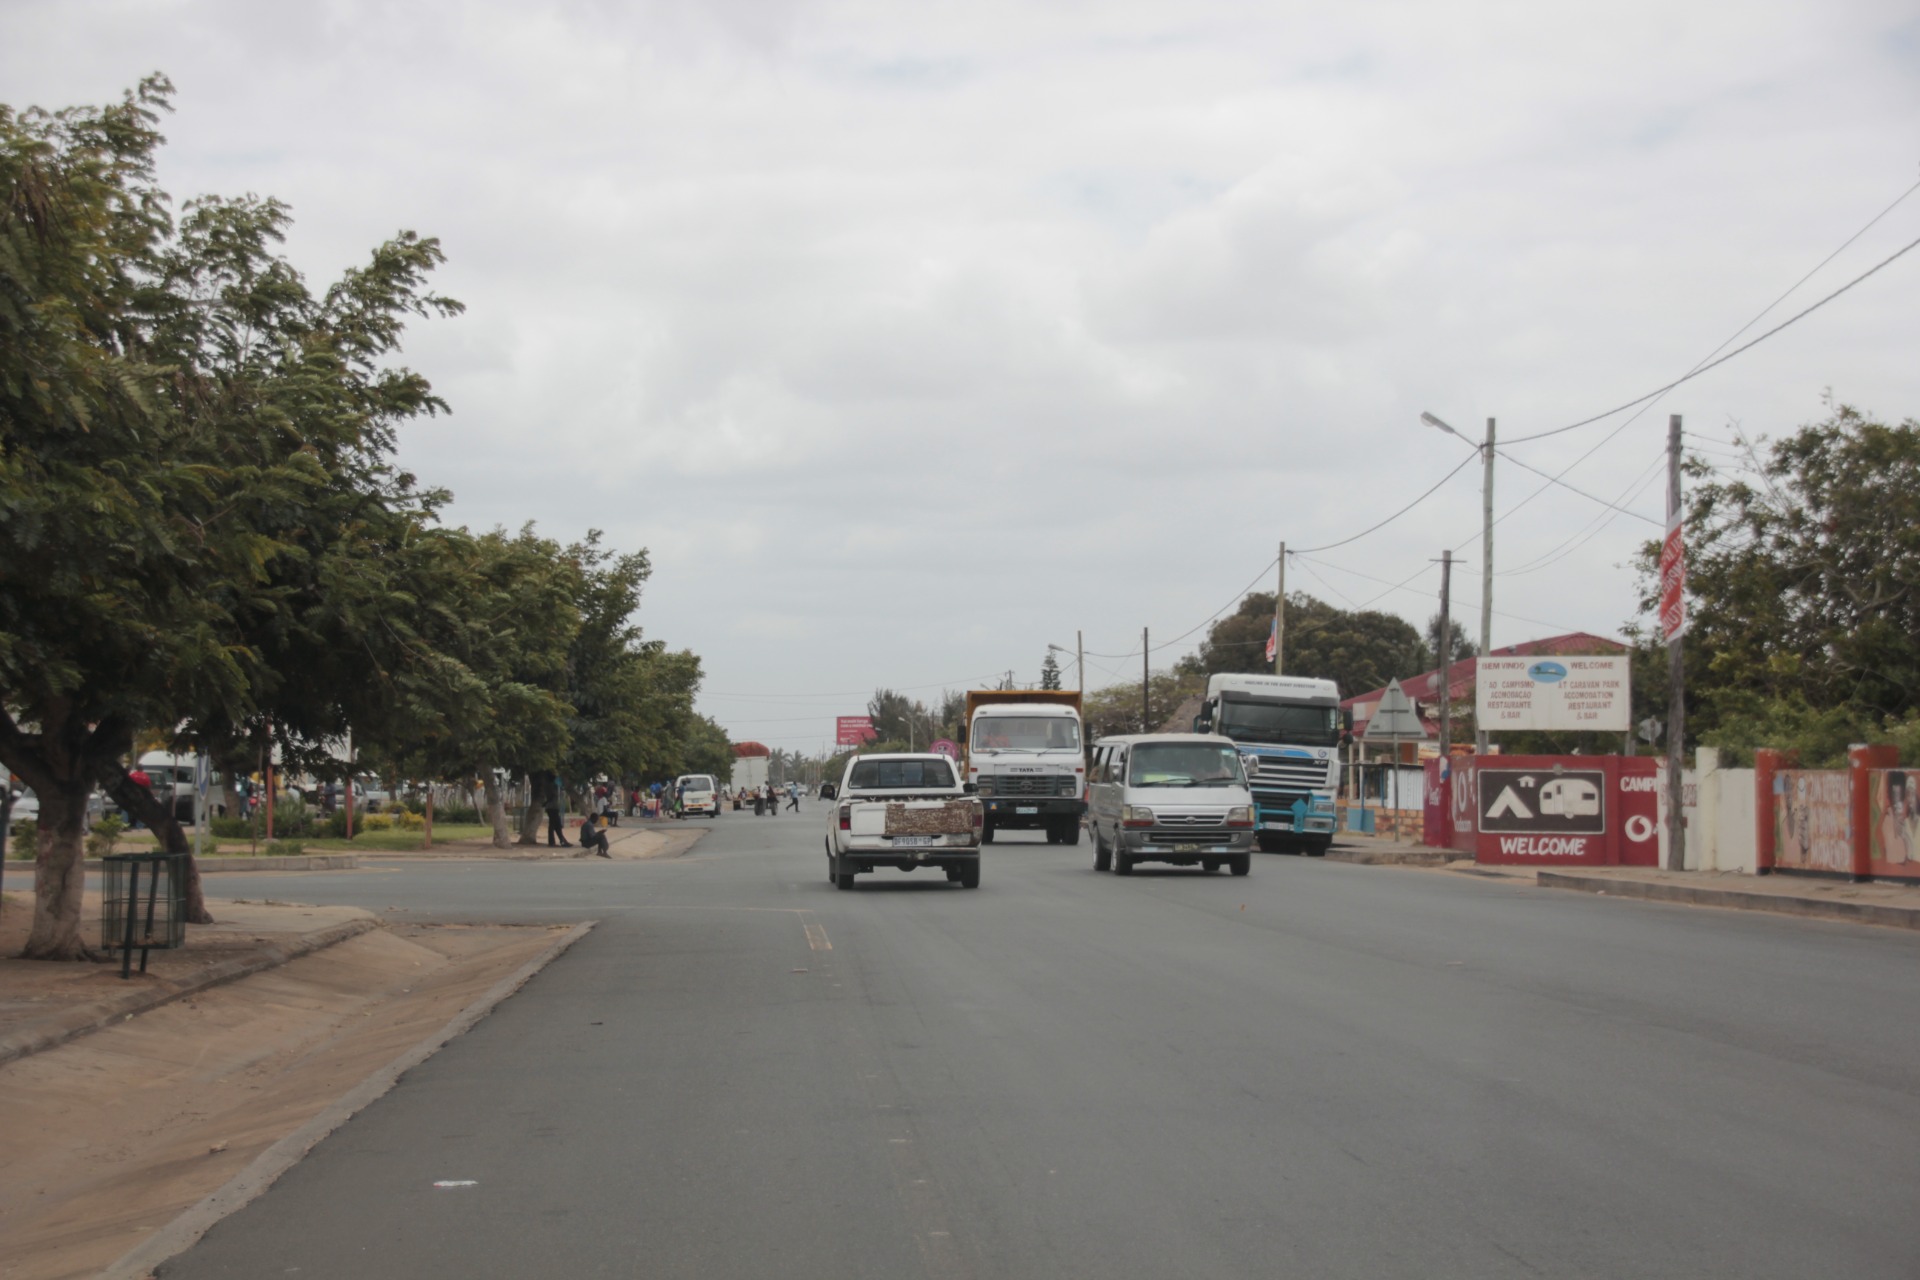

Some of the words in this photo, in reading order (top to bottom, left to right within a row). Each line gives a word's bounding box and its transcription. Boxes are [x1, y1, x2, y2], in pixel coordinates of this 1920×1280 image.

[1482, 662, 1500, 670] BEM
[1501, 662, 1525, 670] VINDO
[1570, 662, 1613, 670] WELCOME
[1488, 681, 1497, 689] AO
[1502, 681, 1535, 689] CAMPISMO
[1570, 681, 1600, 689] CARAVAN
[1602, 680, 1620, 688] PARK
[1563, 691, 1613, 700] ACCOMODATION
[1487, 701, 1532, 709] RESTAURANTE
[1568, 701, 1612, 710] RESTAURANT
[1507, 711, 1521, 719] BAR
[1583, 712, 1598, 720] BAR
[1500, 837, 1587, 856] WELCOME
